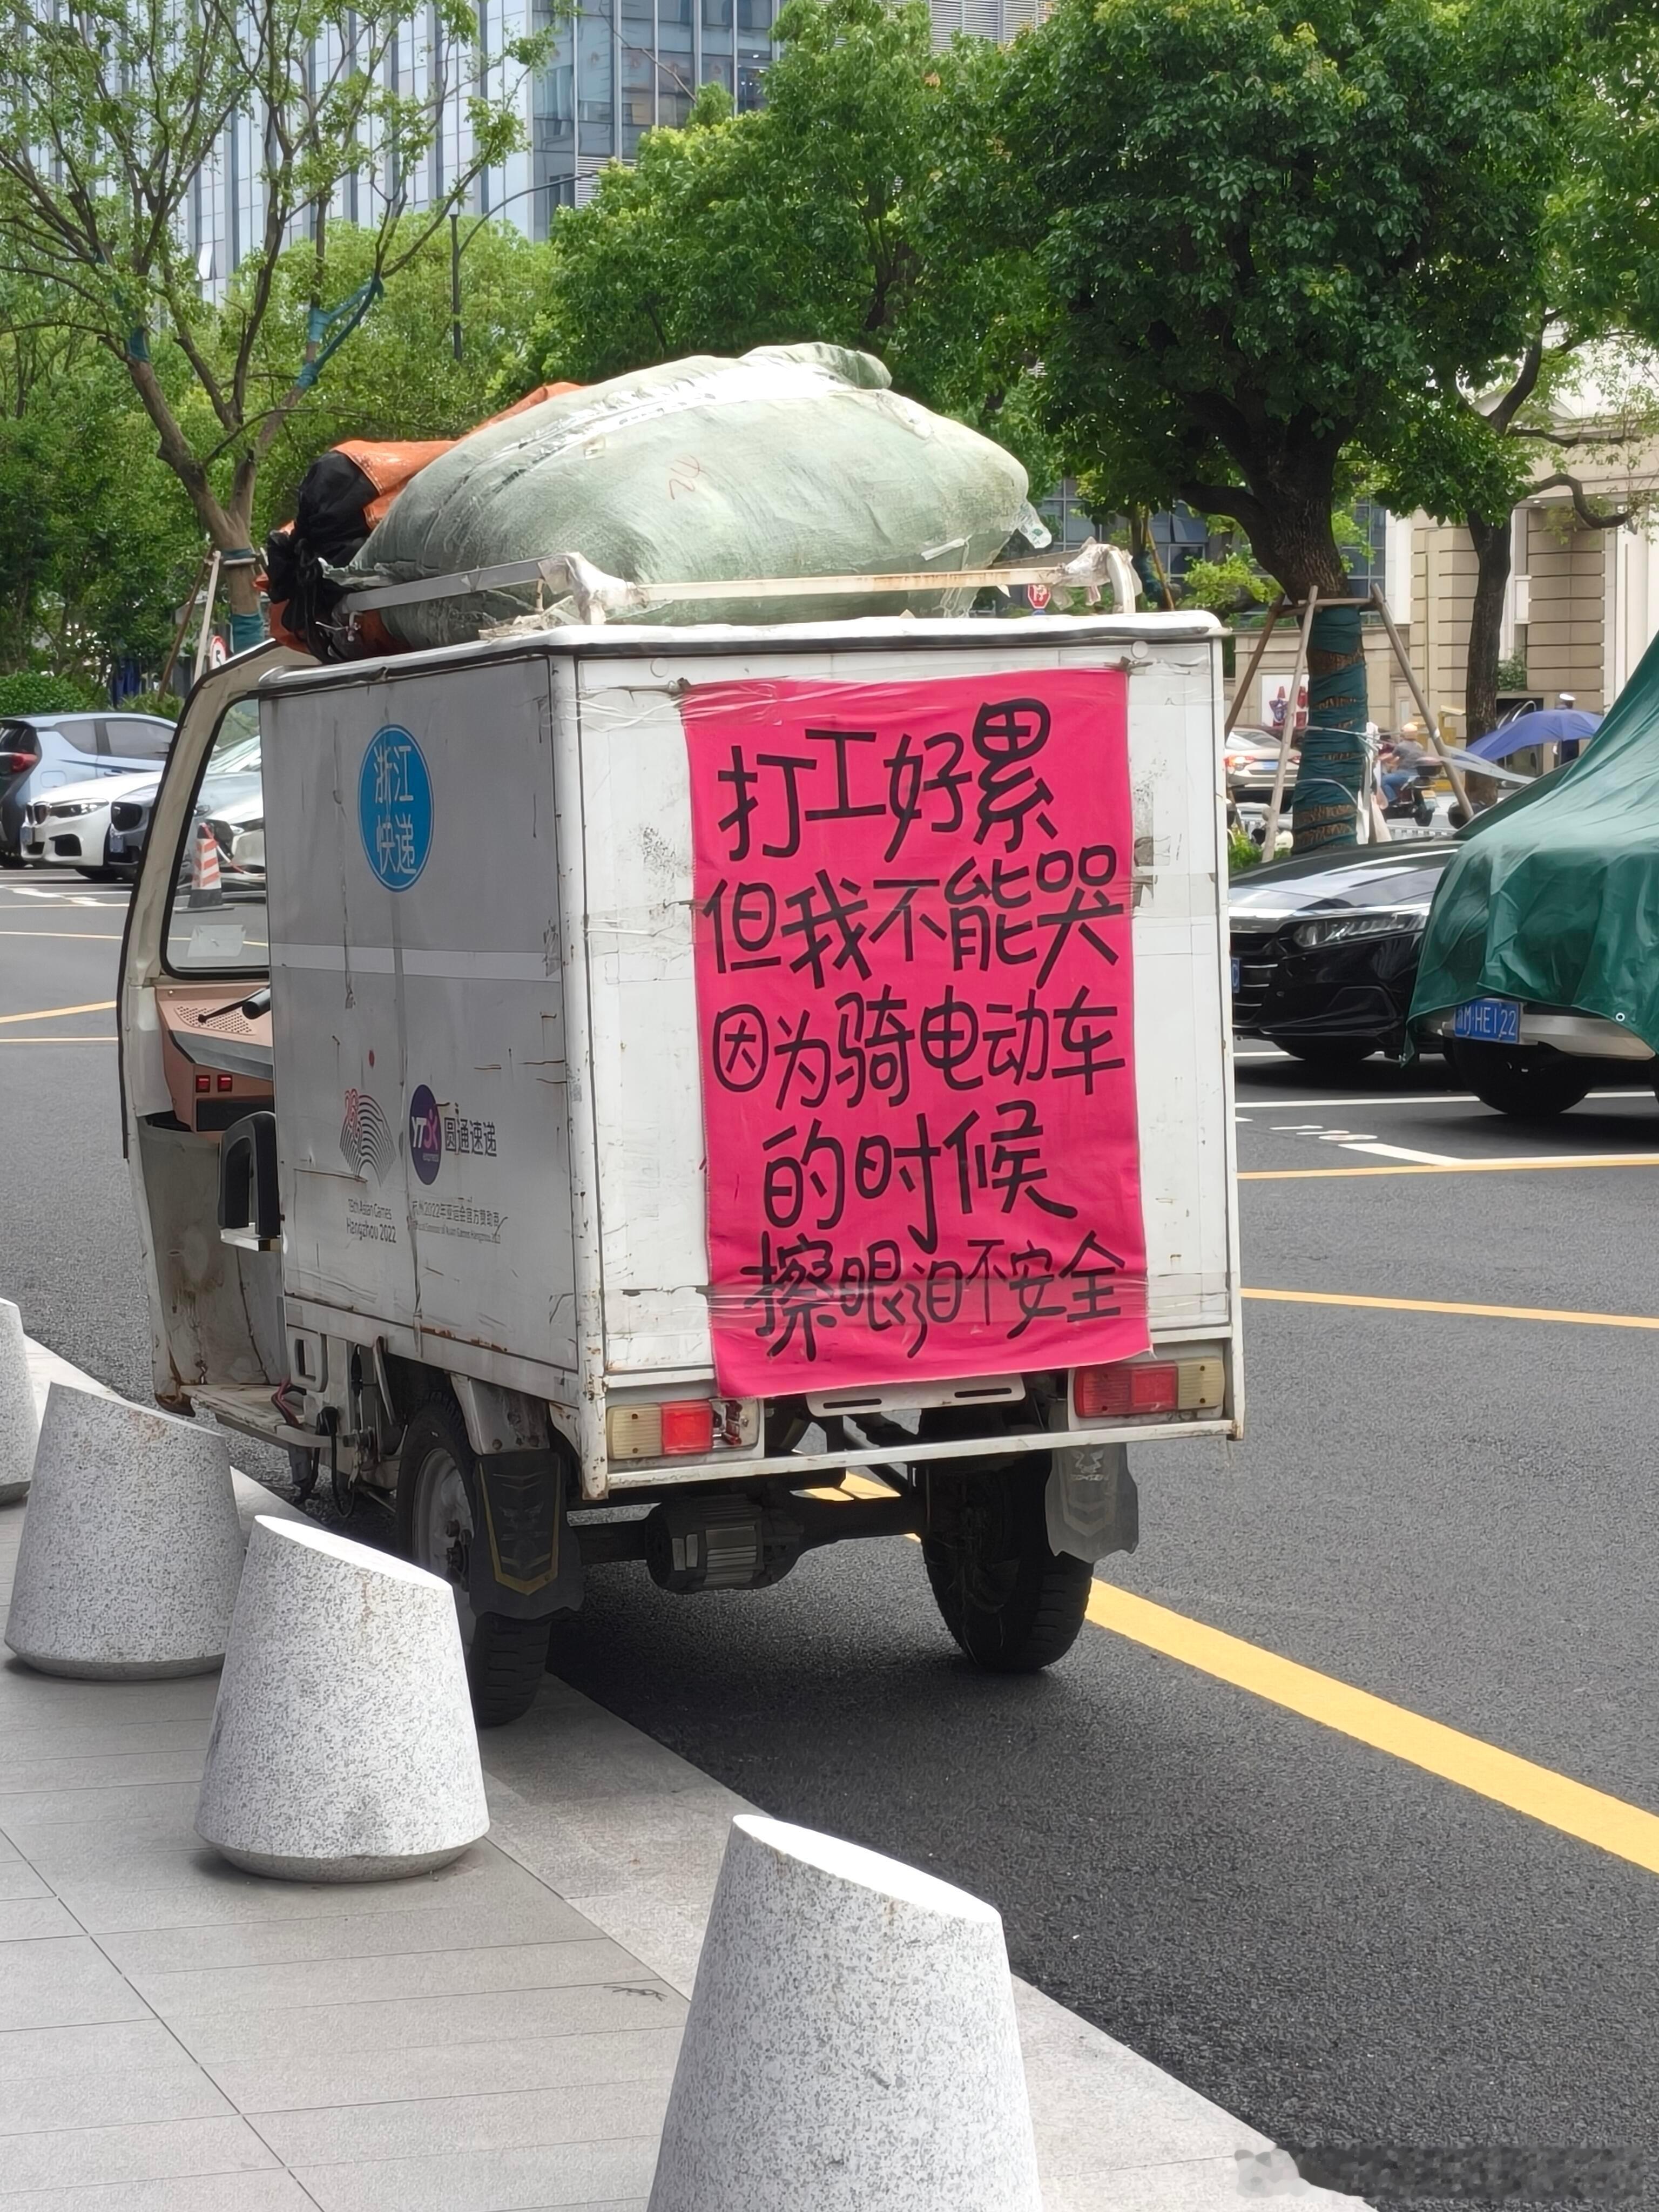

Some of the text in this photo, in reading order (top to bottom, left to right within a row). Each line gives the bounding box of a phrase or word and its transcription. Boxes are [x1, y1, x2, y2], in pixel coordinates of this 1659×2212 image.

[373, 745, 414, 804] 浙江
[718, 698, 1057, 862] 打工好累
[376, 813, 416, 874] 快递
[703, 846, 1124, 989] 但我不能哭
[713, 986, 1124, 1108] 因为骑电动车
[444, 1117, 497, 1157] 圆通速递
[763, 1101, 1077, 1255] 的时候
[380, 1224, 396, 1243] 2022
[740, 1230, 1125, 1361] 擦眼泪不安全
